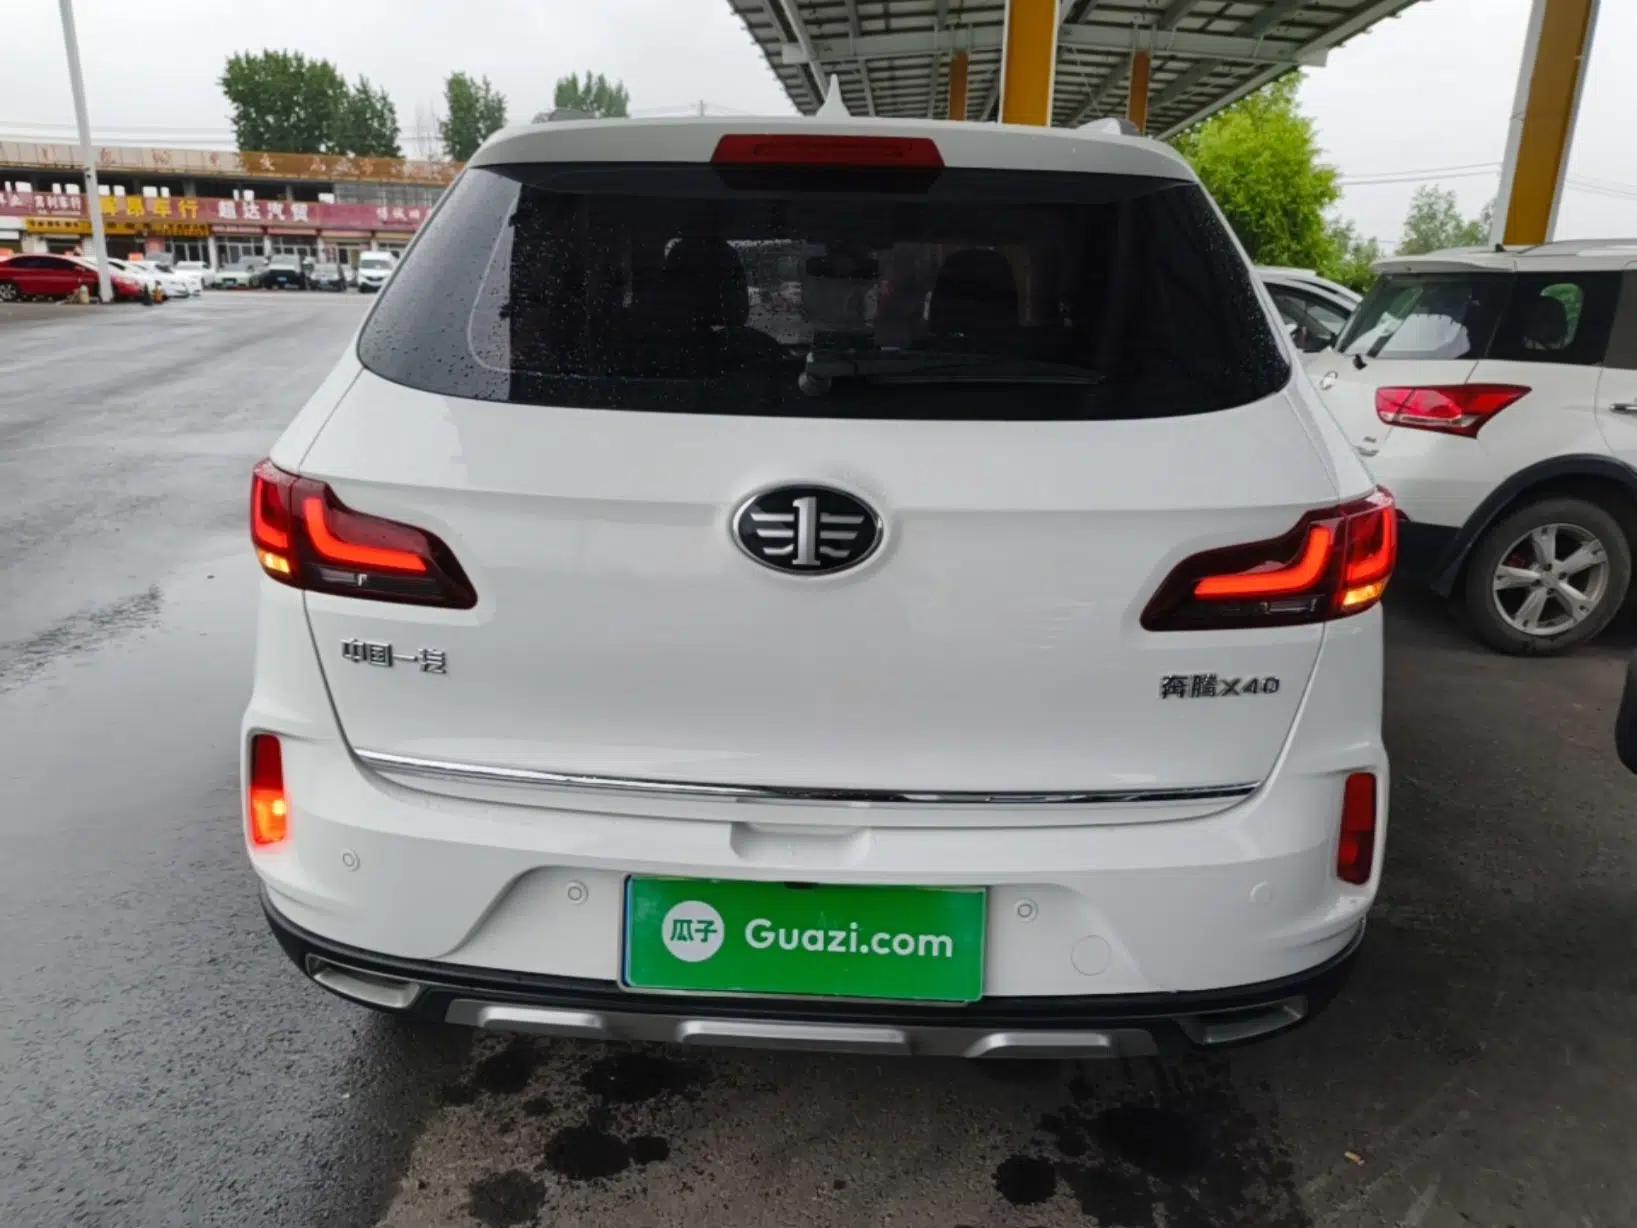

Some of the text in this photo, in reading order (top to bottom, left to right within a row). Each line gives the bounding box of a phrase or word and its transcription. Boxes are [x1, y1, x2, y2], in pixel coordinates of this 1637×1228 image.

[341, 638, 447, 675] 中国一汽
[669, 917, 953, 958] 瓜子 Guazi.com
